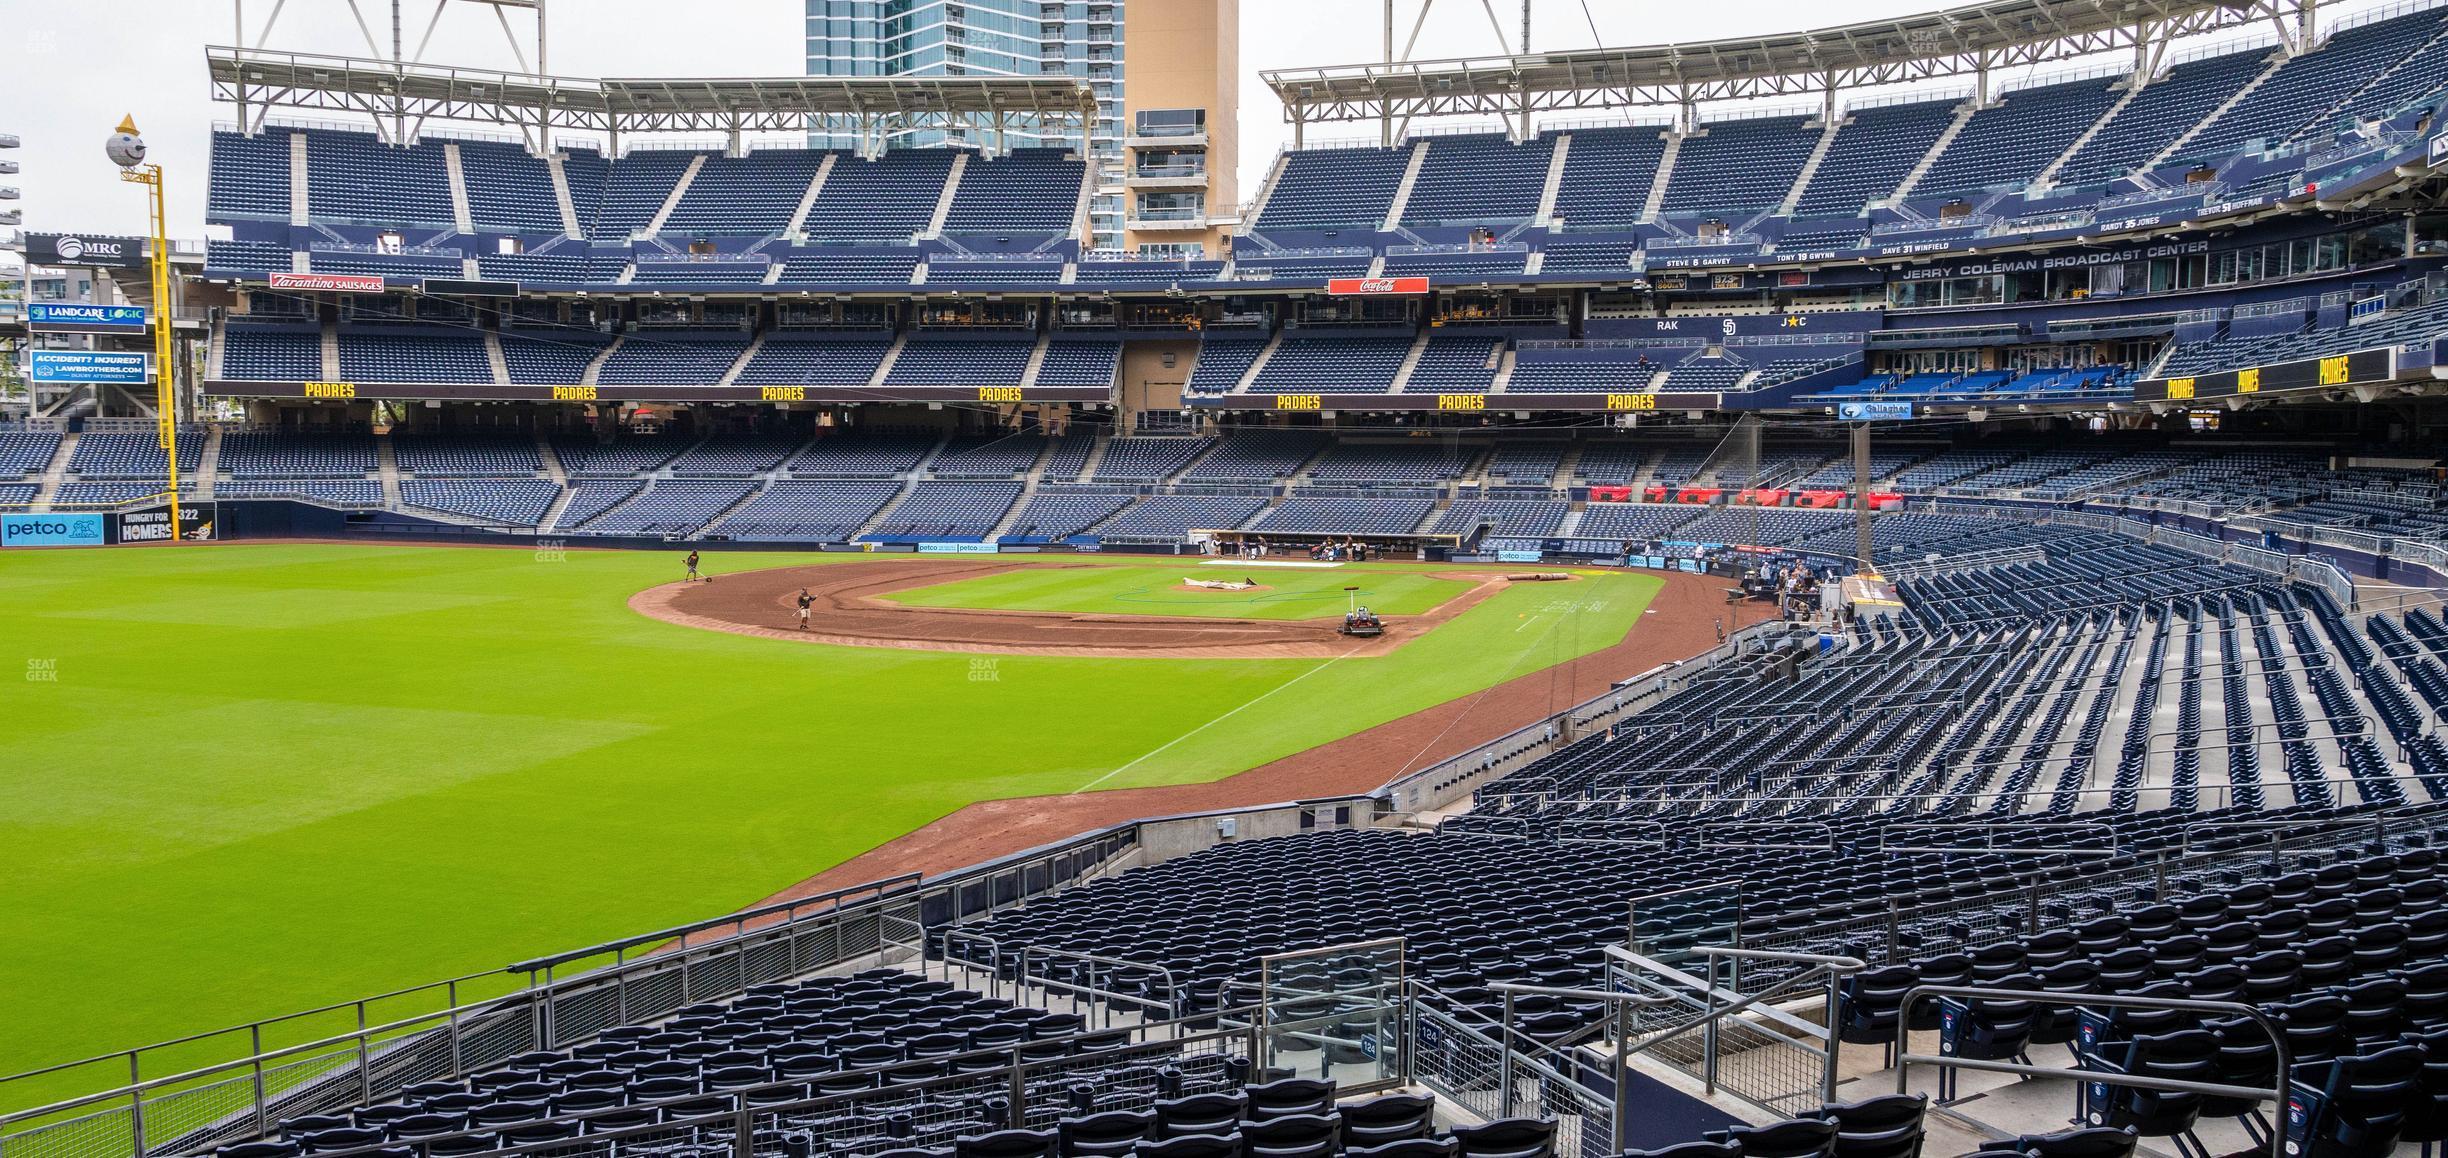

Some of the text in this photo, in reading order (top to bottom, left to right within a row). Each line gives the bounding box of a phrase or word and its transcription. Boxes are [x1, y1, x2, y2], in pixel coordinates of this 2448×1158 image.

[2197, 198, 2263, 217] TREVOR 51 HOFFMAN
[2101, 216, 2160, 232] RANDY 35 JONES
[84, 242, 122, 255] MRC
[1882, 242, 1949, 255] DAVE 31 WINFIELD
[1702, 258, 1731, 266] GARVEY
[1777, 252, 1835, 262] TONY 19 GWYNN
[1903, 240, 2208, 280] JERRY COLEMAN BROADCAST CENTER
[273, 274, 382, 291] Tarantino SAUSAGES
[48, 307, 143, 319] LANDCARE LOGIC
[1657, 321, 1678, 330] RAK
[36, 355, 92, 363] ACCIDENT?
[2319, 356, 2349, 385] PADRES
[2237, 369, 2260, 393] PADRES
[305, 383, 355, 398] PADRES
[554, 386, 597, 400] PADRES
[762, 387, 804, 400] PADRES
[979, 387, 1021, 401] PADRES
[2167, 378, 2195, 399] PADRES
[1277, 395, 1320, 409] PADRES
[1439, 395, 1484, 409] PADRES
[1607, 394, 1655, 409] PADRES
[1865, 404, 1908, 414] Gallagher
[125, 511, 168, 523] HUNGRY FOR
[179, 509, 199, 520] 322
[8, 520, 67, 539] petco
[122, 523, 172, 540] HOMERS
[1422, 1027, 1437, 1042] 124
[1364, 1041, 1375, 1054] 124
